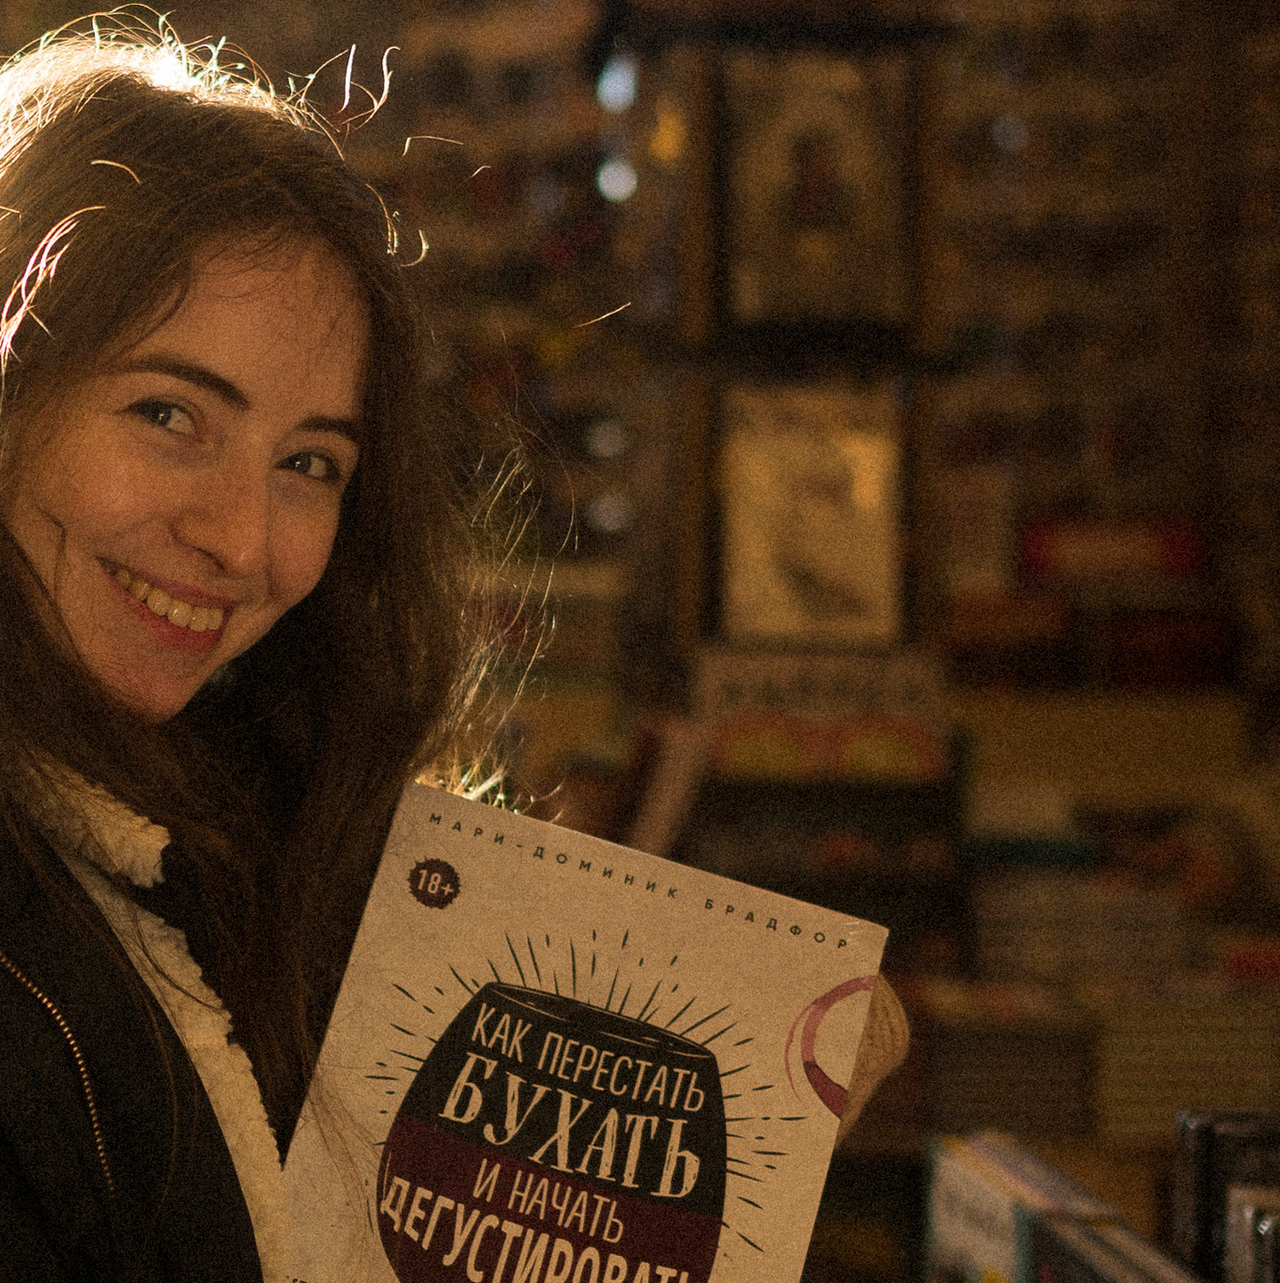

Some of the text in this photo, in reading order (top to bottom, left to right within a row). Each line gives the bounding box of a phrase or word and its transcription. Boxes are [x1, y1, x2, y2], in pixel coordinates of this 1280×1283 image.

[417, 869, 454, 896] 18+
[429, 813, 847, 949] МАРИ-ДОМИНИК БРАДФОР
[471, 1002, 706, 1113] КАК ПЕРЕСТАТЬ
[437, 1051, 702, 1200] БУХАТЬ
[472, 1158, 625, 1245] И НАЧАТЬ
